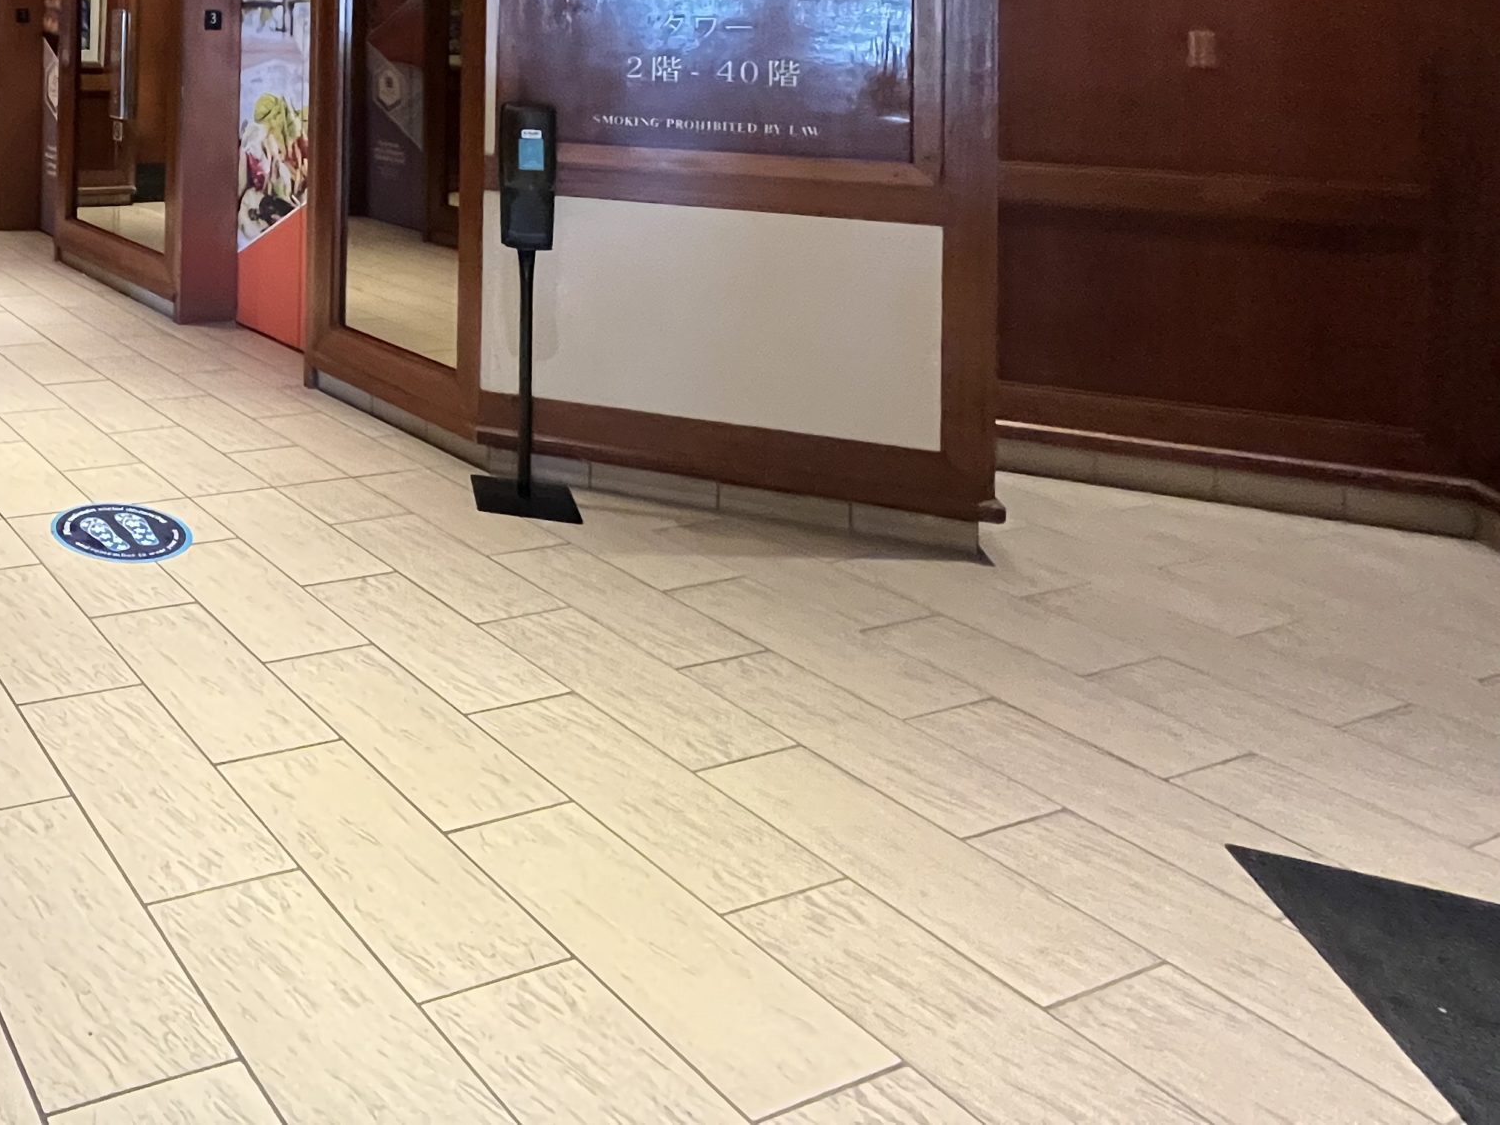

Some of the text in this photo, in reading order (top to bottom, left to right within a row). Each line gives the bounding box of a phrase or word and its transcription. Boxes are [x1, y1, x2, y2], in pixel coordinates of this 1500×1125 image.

[210, 12, 217, 24] 3
[660, 13, 753, 38] タワー
[592, 114, 820, 138] SMOKING PROHIBITED BY LAW
